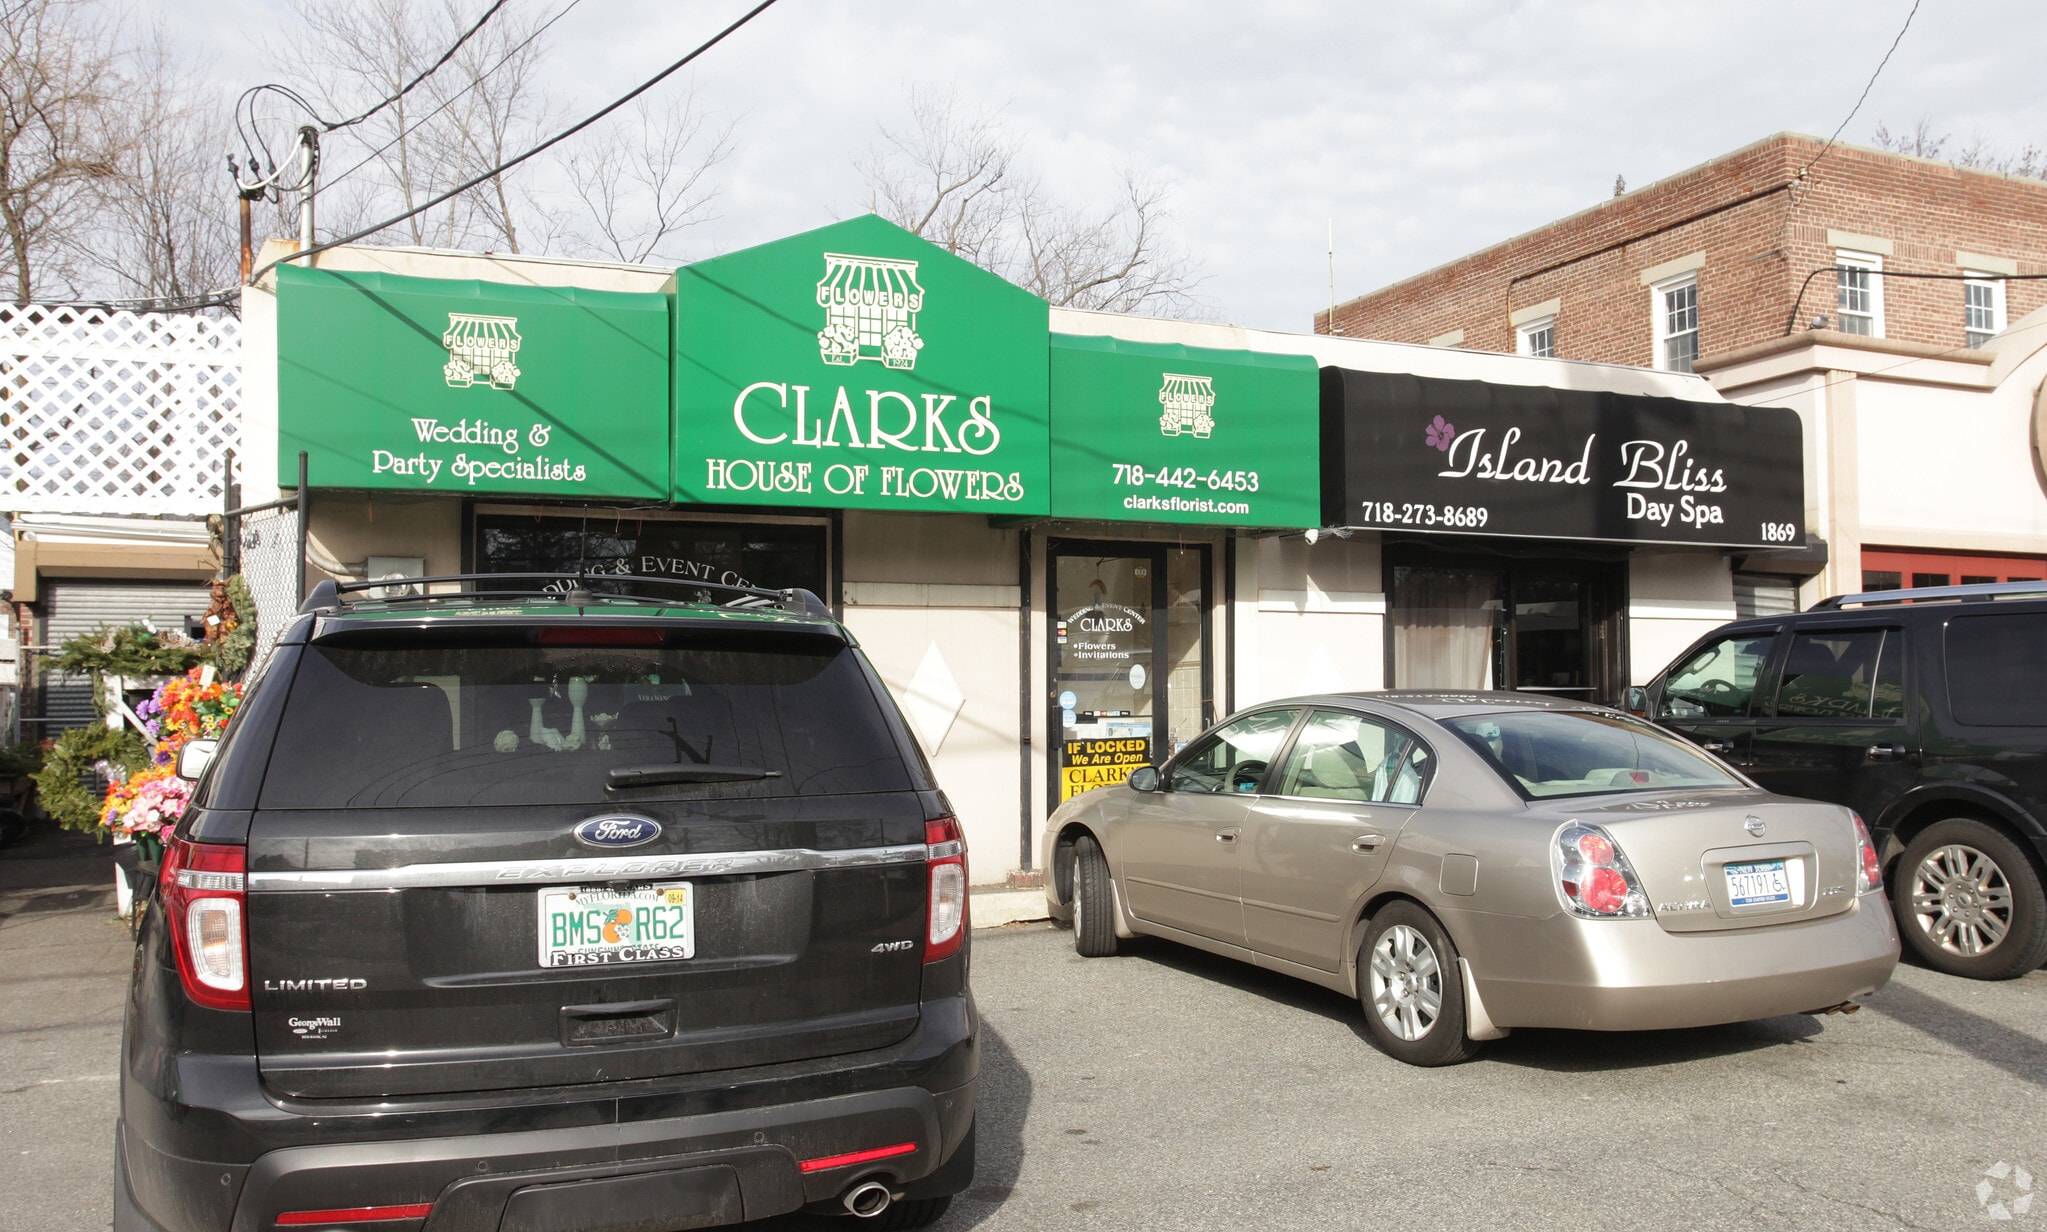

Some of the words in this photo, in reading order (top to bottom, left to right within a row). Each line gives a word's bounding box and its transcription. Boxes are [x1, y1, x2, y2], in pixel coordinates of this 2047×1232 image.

[821, 286, 919, 309] FLOWERS
[446, 335, 517, 350] FLOWERS
[733, 381, 1001, 456] CLARKS
[411, 418, 518, 454] Wedding
[529, 424, 551, 446] &
[373, 450, 443, 484] Party
[451, 453, 587, 486] Specialists
[1438, 427, 1596, 485] Island
[1612, 440, 1727, 493] Bliss
[706, 459, 812, 494] HOUSE
[823, 464, 869, 495] OF
[880, 466, 1025, 501] FLOWERS
[1112, 463, 1260, 492] 718-442-6453
[1123, 495, 1250, 515] clarksflorist.com
[1362, 502, 1488, 528] 718-273-8689
[1627, 493, 1674, 528] Day
[1680, 495, 1724, 529] Spa
[1761, 523, 1795, 542] 1869
[615, 558, 632, 575] &
[641, 555, 715, 580] EVENT
[1080, 618, 1133, 632] CLARKS
[1123, 606, 1146, 625] CENTER
[1078, 651, 1130, 659] Invitations
[1067, 742, 1082, 754] IF
[1086, 739, 1146, 754] LOCKED
[1072, 754, 1089, 765] We
[1091, 753, 1111, 764] Are
[1114, 752, 1143, 764] Open
[1069, 766, 1138, 783] CLARK'
[594, 820, 642, 841] Ford
[495, 857, 736, 880] EXPLORER
[1731, 874, 1770, 897] 567191
[552, 909, 601, 947] BMS
[635, 905, 684, 942] R62
[551, 950, 612, 966] FIRST
[619, 946, 684, 961] CLASS
[870, 940, 914, 953] 4WD
[264, 978, 368, 991] LIMITED
